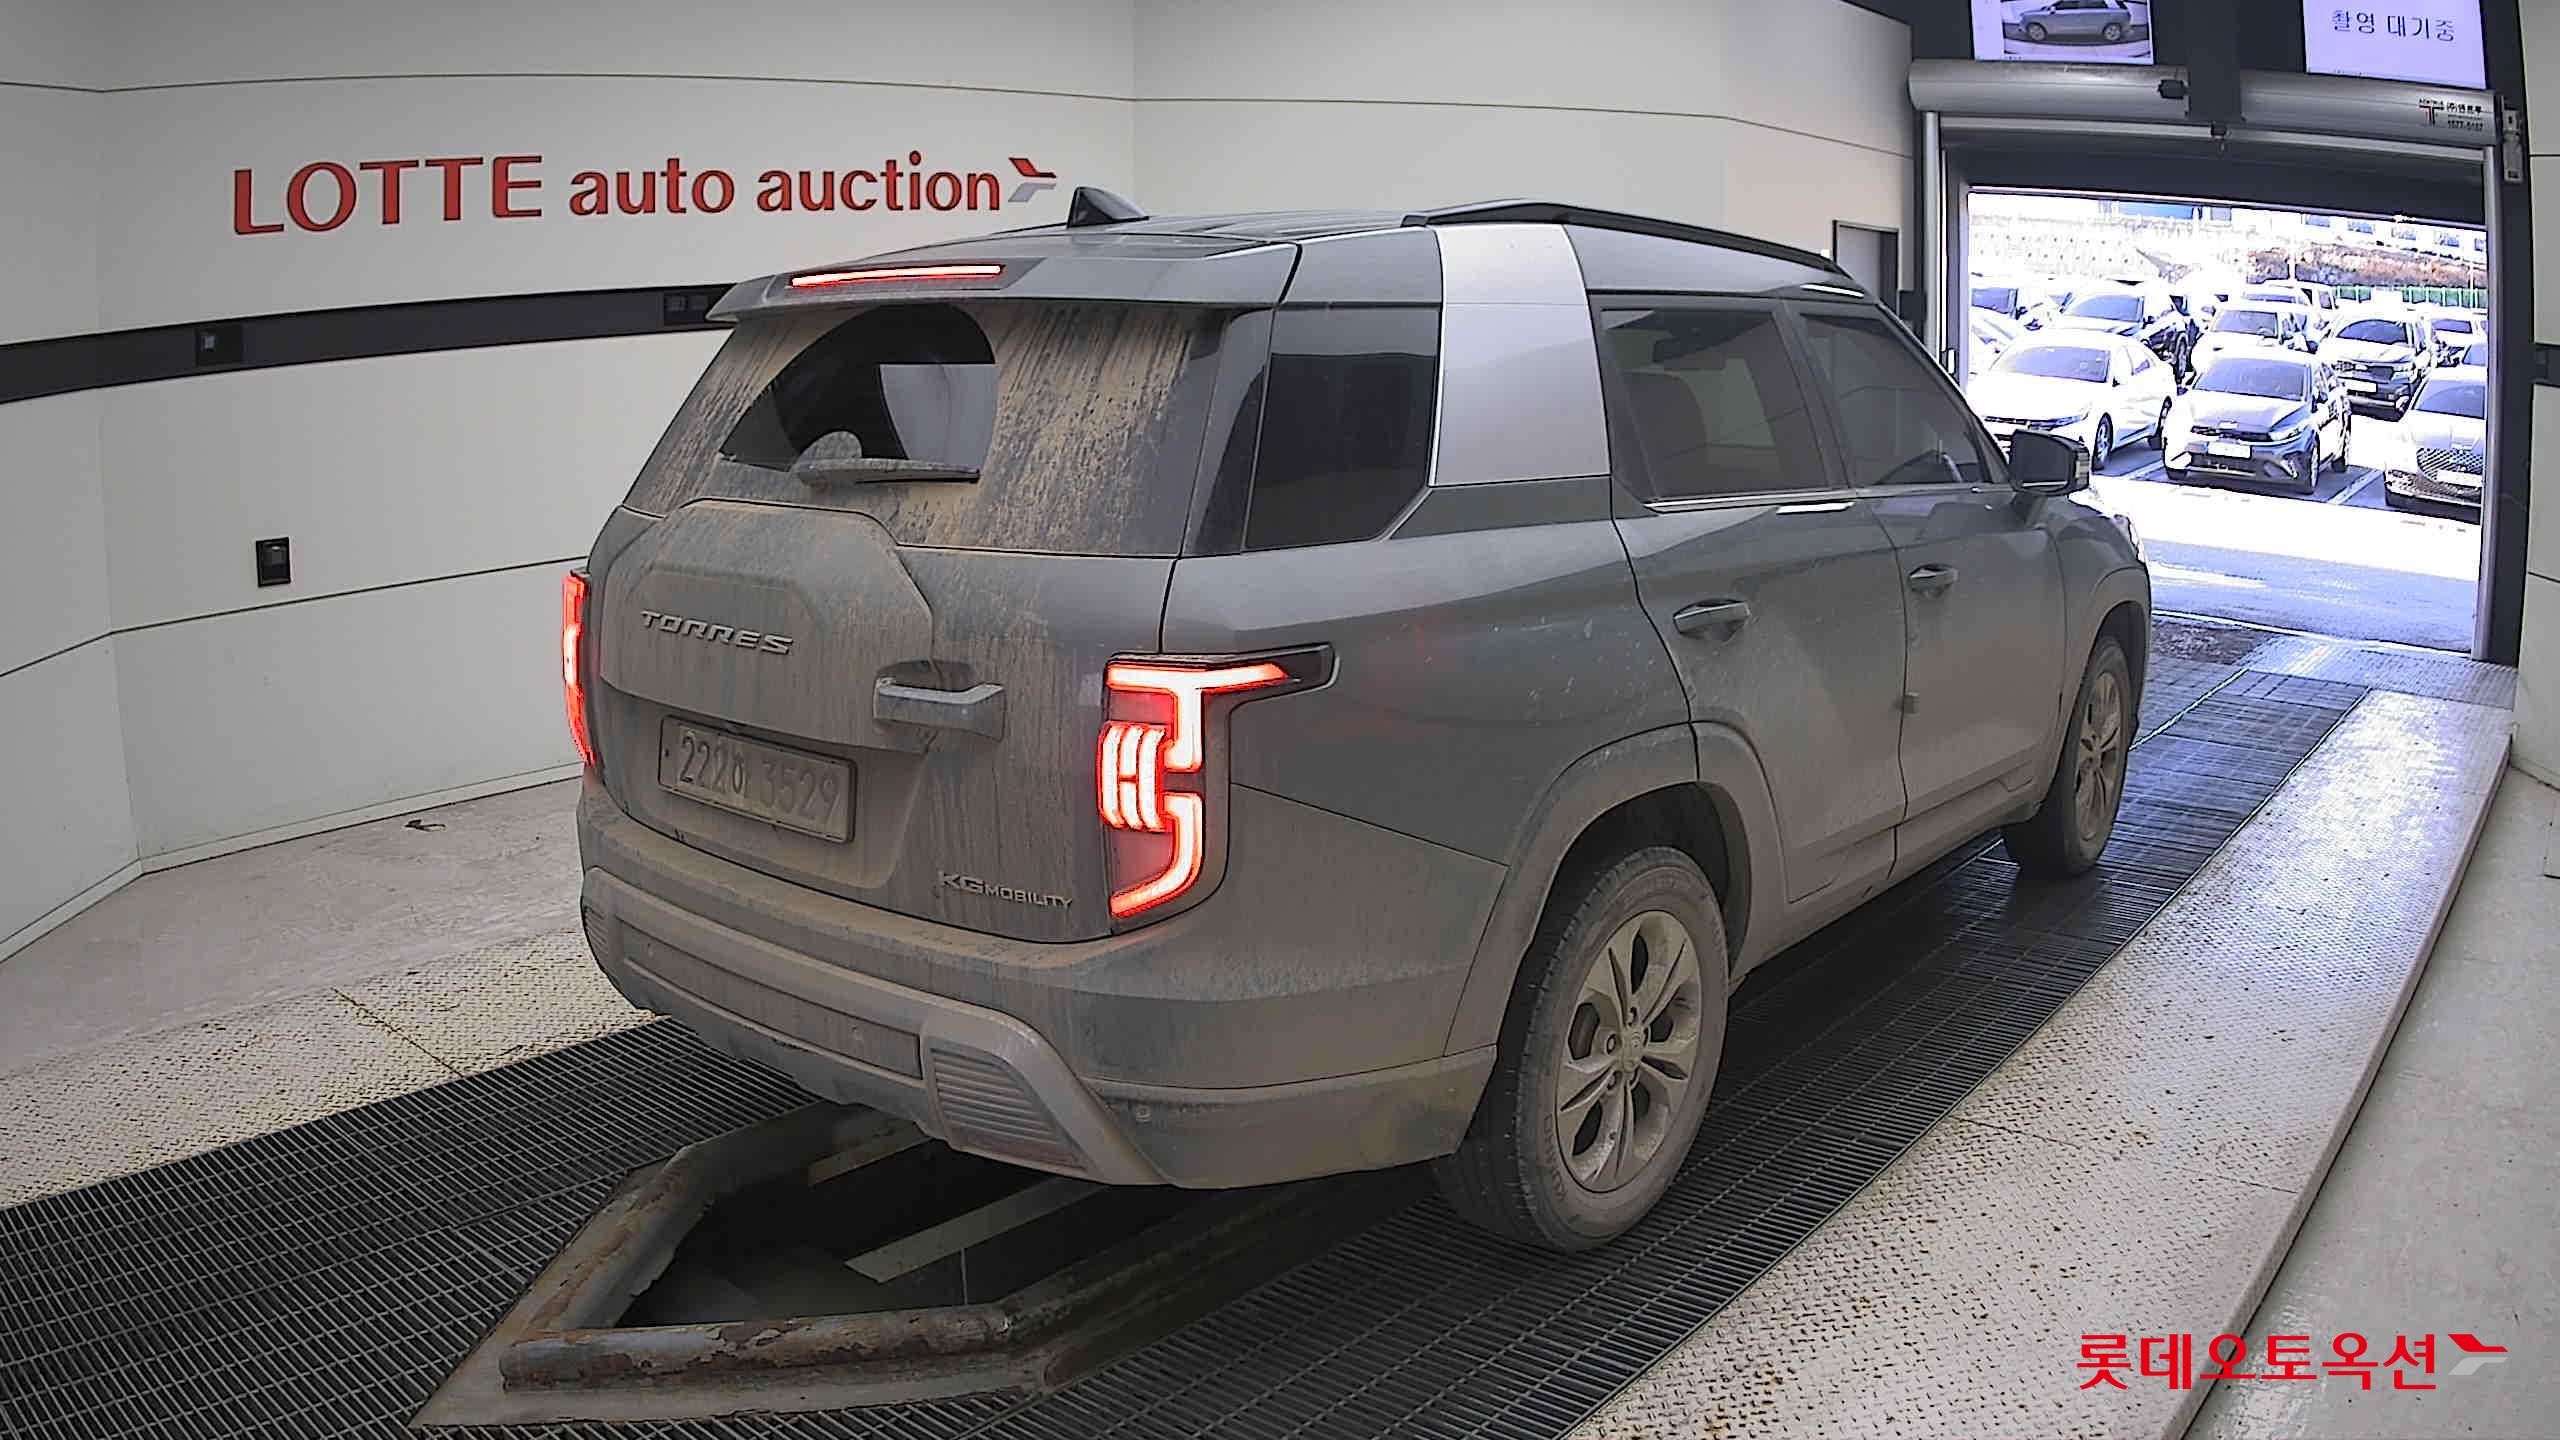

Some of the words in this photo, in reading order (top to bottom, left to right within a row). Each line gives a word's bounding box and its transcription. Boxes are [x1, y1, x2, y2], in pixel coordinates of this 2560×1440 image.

[2332, 9, 2375, 34] 촬영
[2387, 15, 2455, 42] 대기중
[233, 154, 543, 235] LOTTE
[568, 157, 735, 216] auto
[756, 150, 1001, 213] auction
[640, 609, 794, 655] TORRES
[760, 758, 841, 826] 3529
